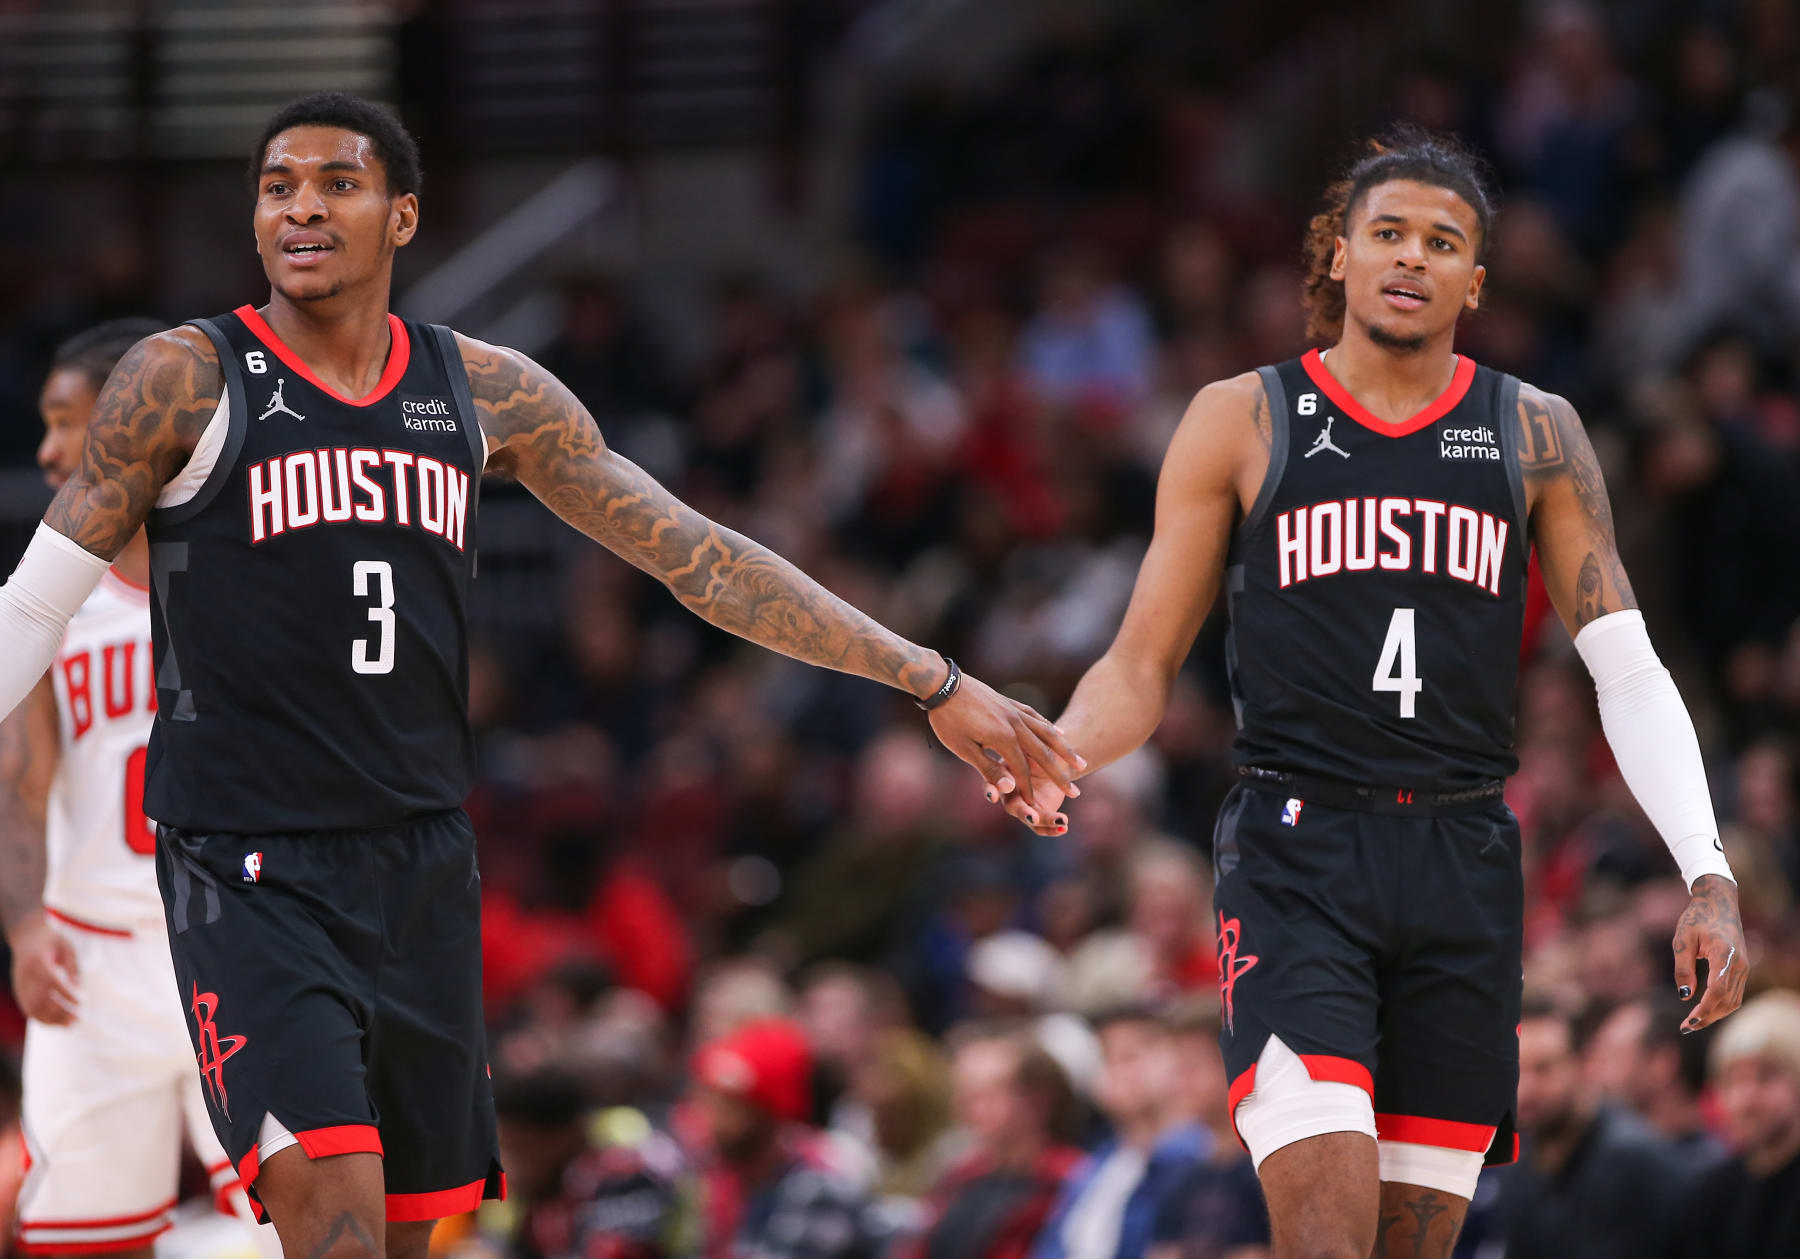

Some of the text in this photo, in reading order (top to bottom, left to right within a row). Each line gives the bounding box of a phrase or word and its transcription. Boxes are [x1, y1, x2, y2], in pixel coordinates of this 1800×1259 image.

[245, 351, 268, 374] 6
[402, 399, 449, 414] credit
[1297, 392, 1318, 416] 6
[402, 413, 457, 432] karma
[1443, 427, 1495, 444] credit
[1440, 442, 1500, 461] karma
[249, 448, 469, 551] HOUSTON
[1277, 497, 1508, 596] HOUSTON
[351, 560, 396, 675] 3
[1372, 607, 1423, 719] 4
